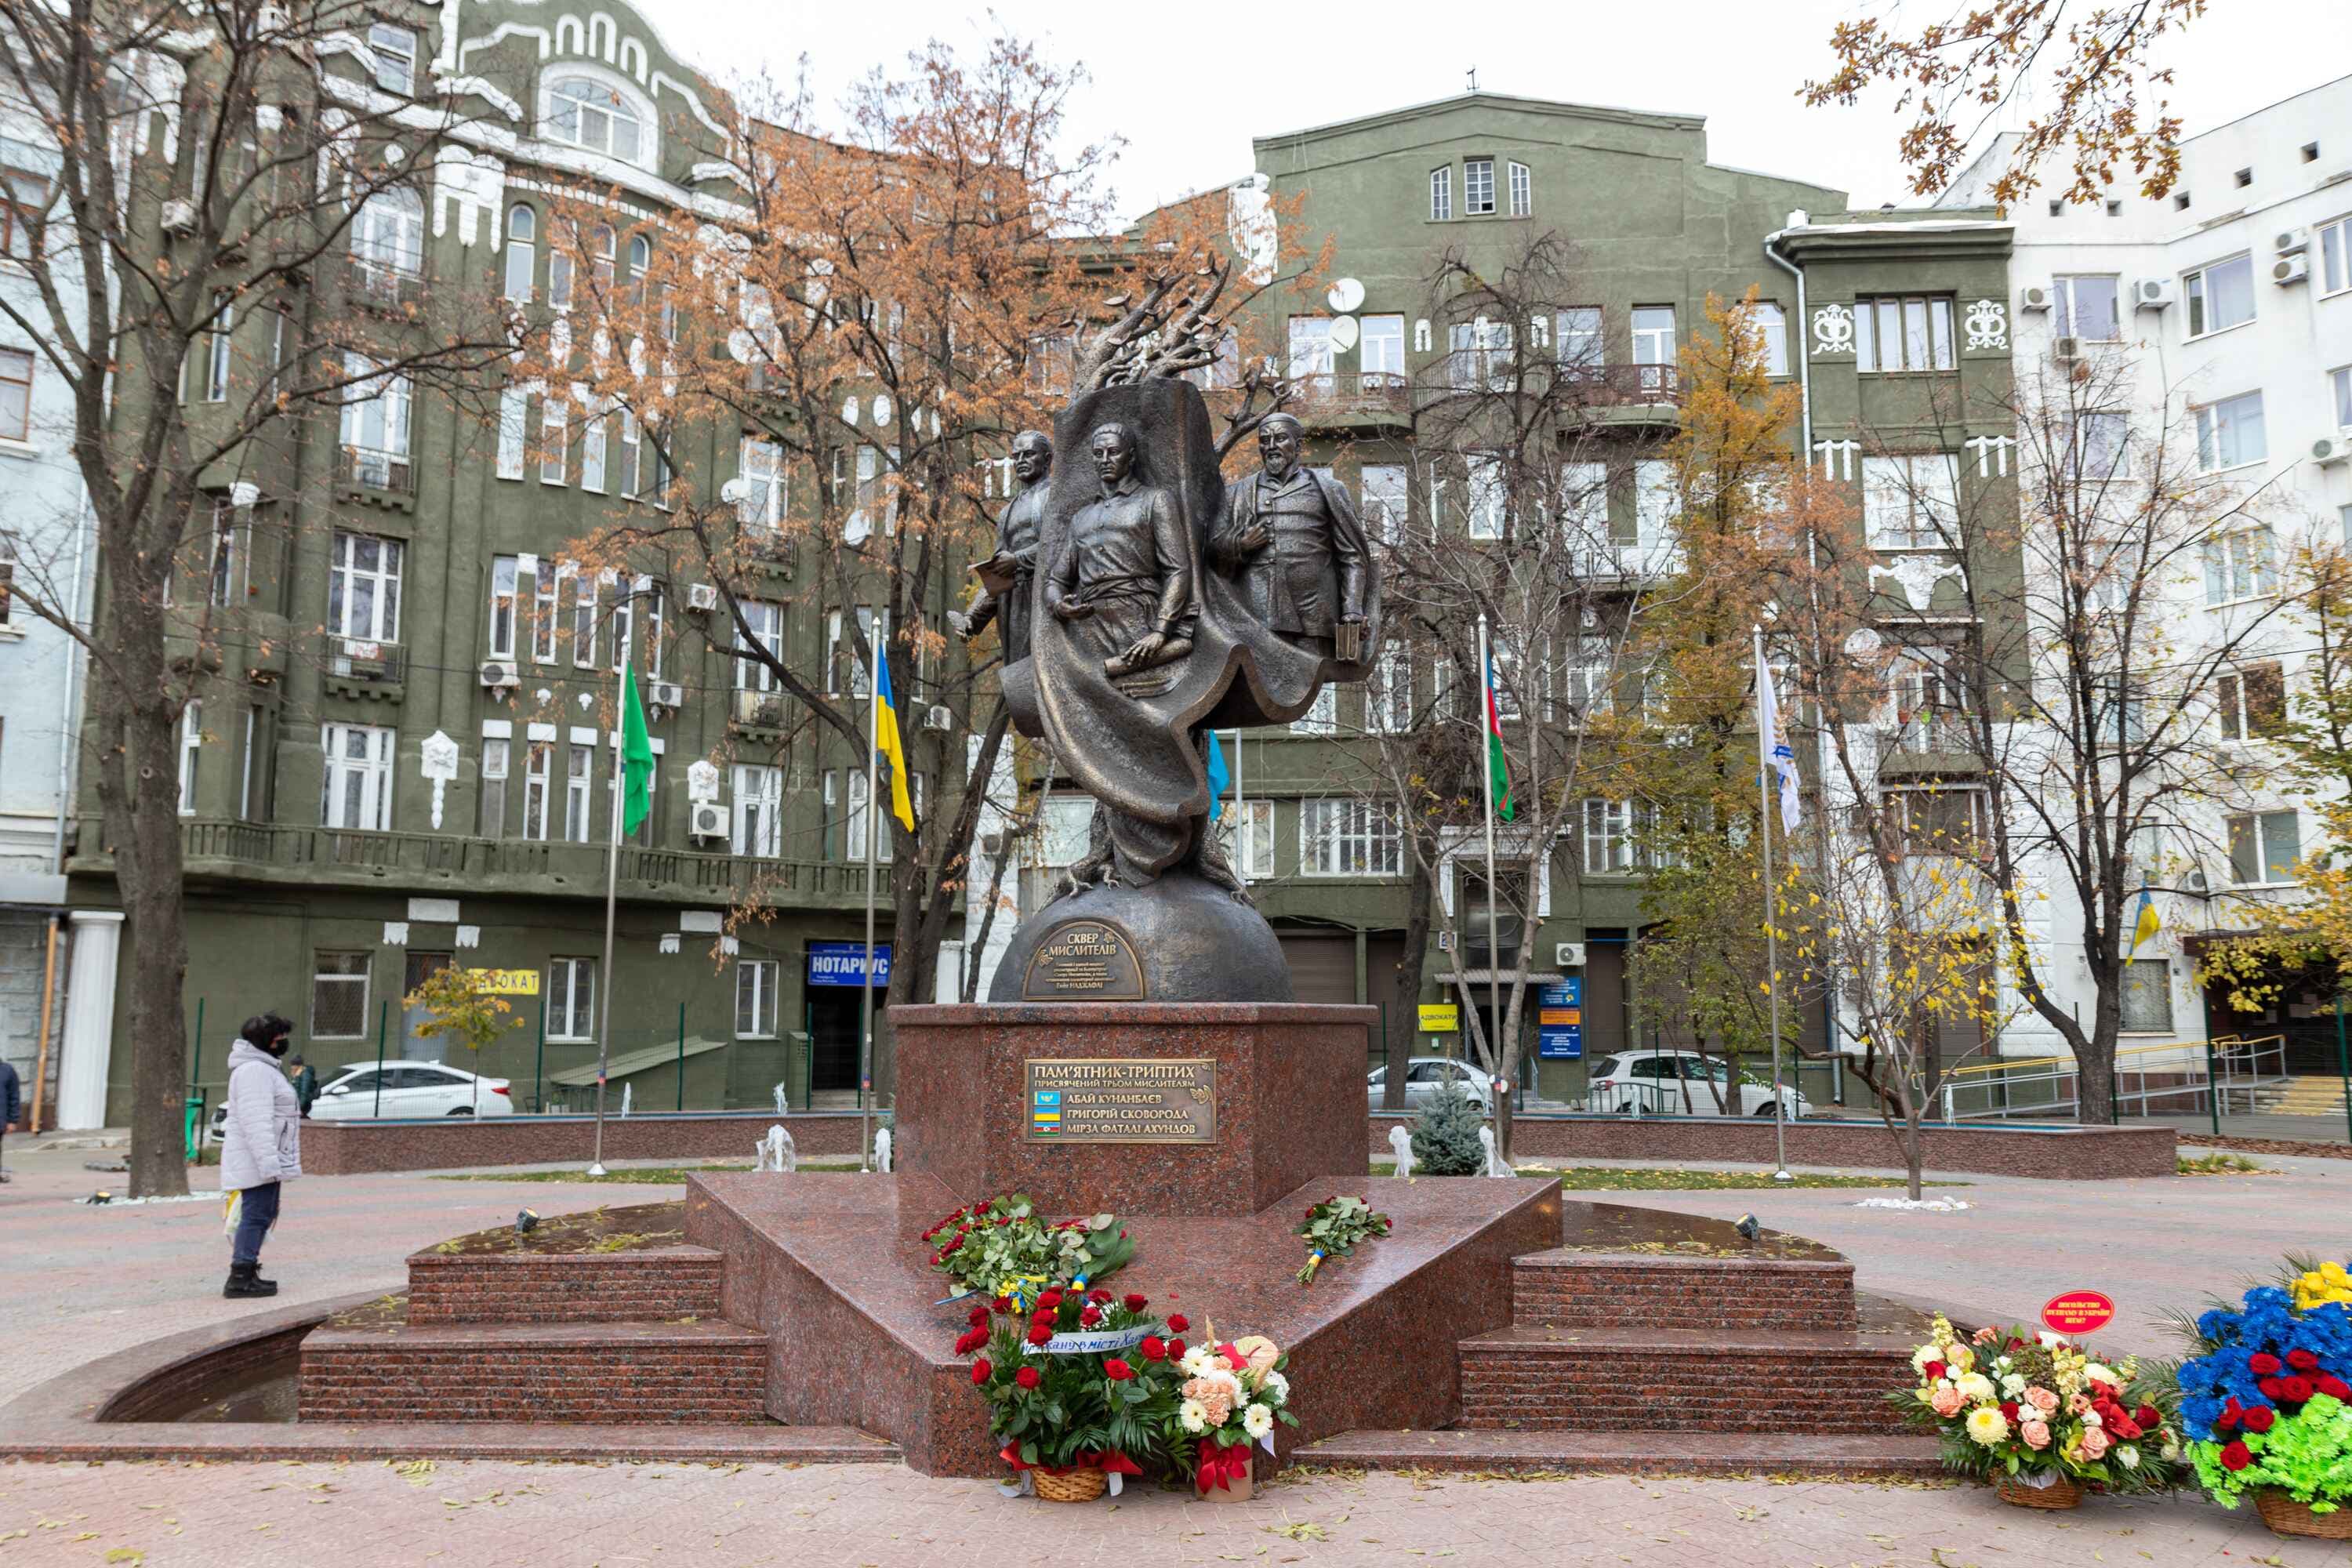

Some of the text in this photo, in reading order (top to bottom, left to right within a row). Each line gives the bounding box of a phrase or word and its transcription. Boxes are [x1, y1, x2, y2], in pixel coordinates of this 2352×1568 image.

[1067, 934, 1098, 944] СКВЕР
[1049, 945, 1116, 956] МИСЛИТЕЛІВ
[1034, 1066, 1195, 1078] ПАМ'ЯТНИК-ТРИПТИХ
[1034, 1079, 1099, 1087] ПРИСВЯЧЕНИЙ
[1067, 1094, 1162, 1104] АБАЙ КУНАНБАЄВ
[1067, 1109, 1189, 1120] ГРИГОРІЙ СКОВОРОДА
[1067, 1124, 1196, 1134] МІРЗА ФАТАЛІ АХУНДОВ
